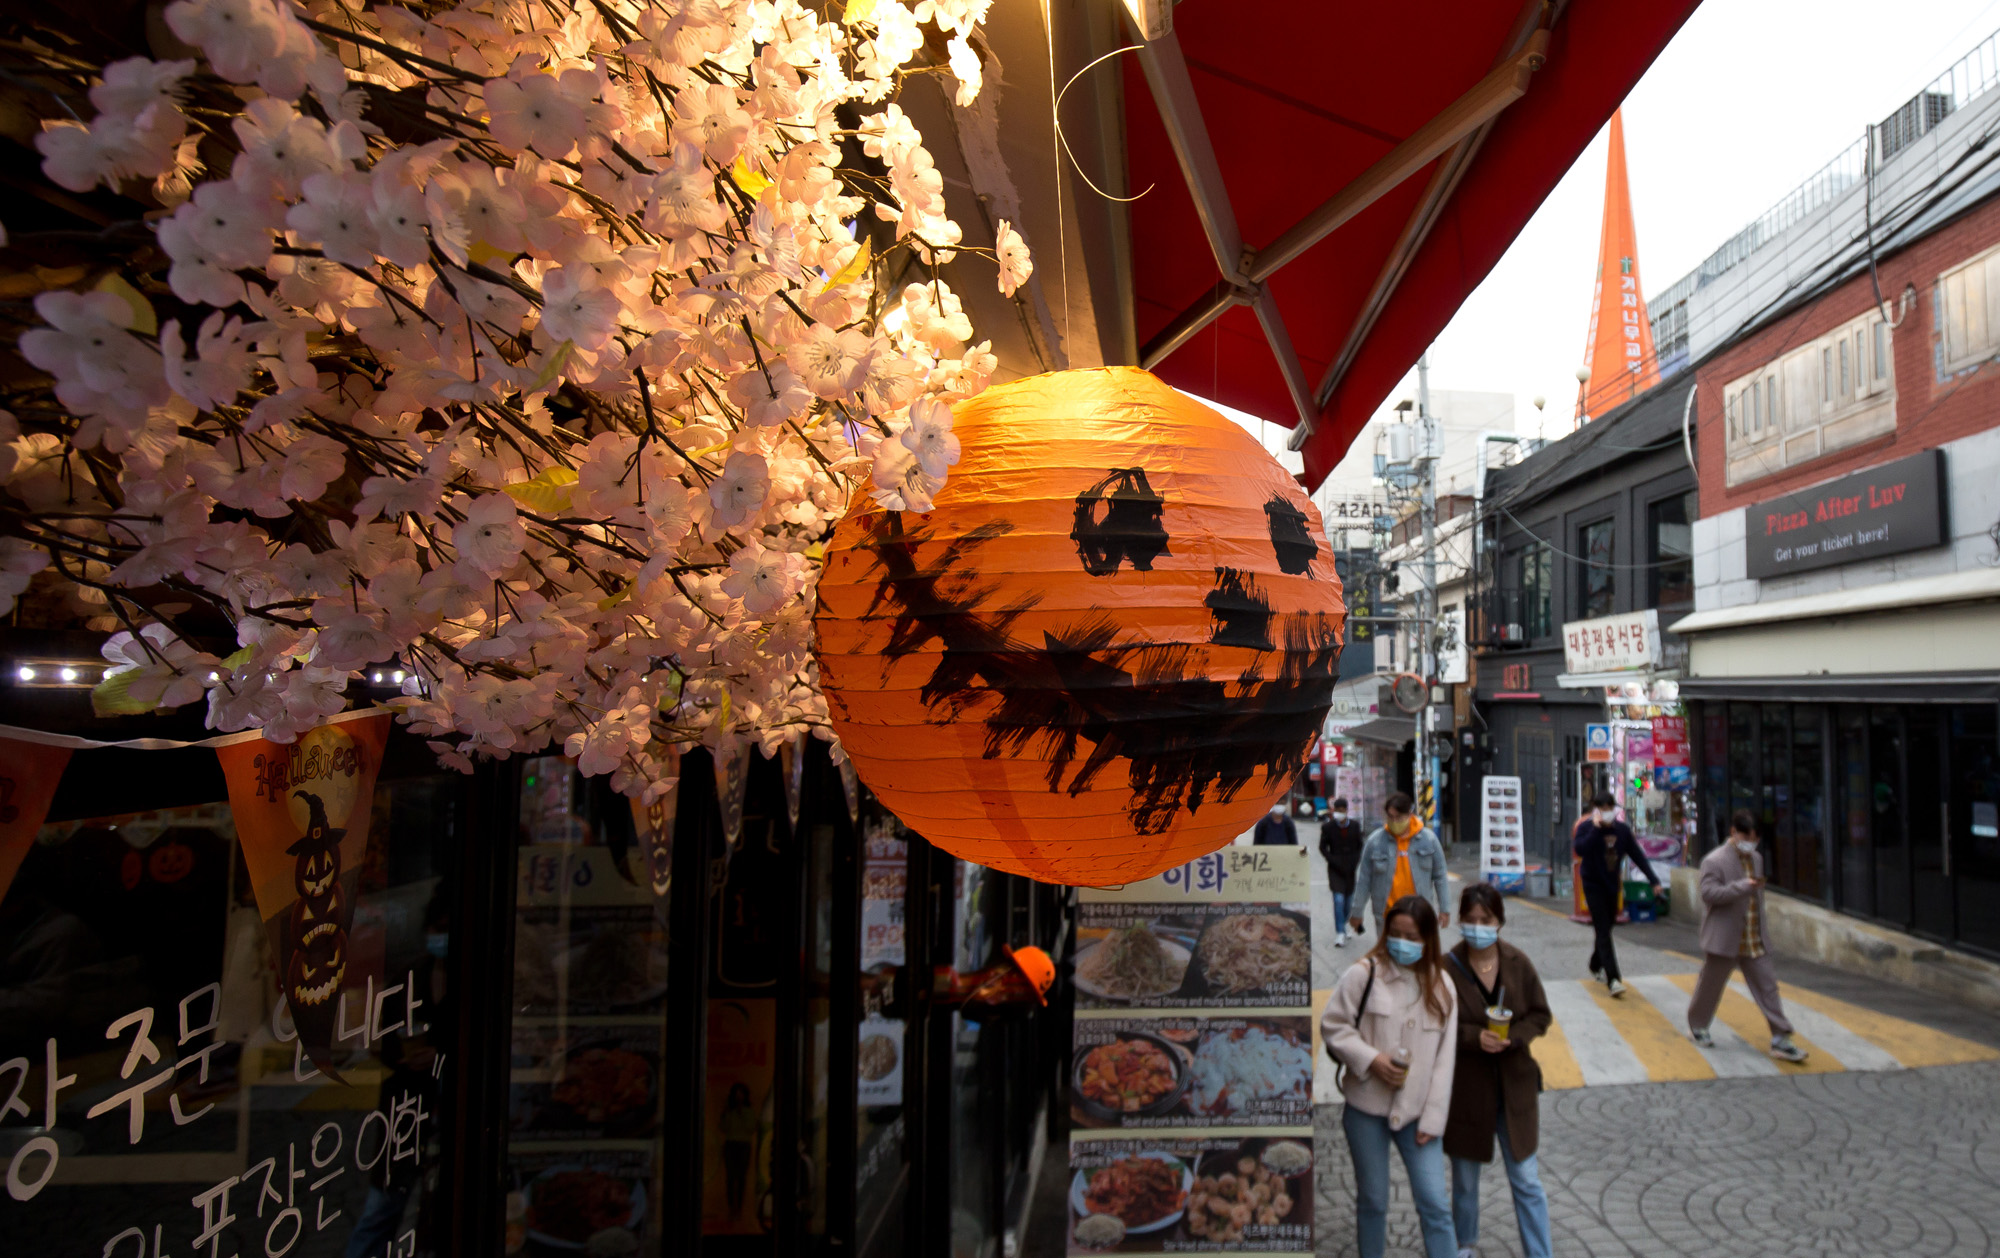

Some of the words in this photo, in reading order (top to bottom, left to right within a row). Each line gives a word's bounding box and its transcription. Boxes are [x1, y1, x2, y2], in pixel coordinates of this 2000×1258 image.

[1765, 510, 1808, 536] Pizza
[1815, 495, 1862, 523] After
[1868, 483, 1907, 510] Luv
[1775, 547, 1792, 562] Get
[1796, 543, 1820, 561] your
[1821, 533, 1854, 552] ticket
[1858, 523, 1889, 546] here!
[253, 740, 365, 803] Halloween
[1324, 746, 1338, 762] P
[87, 982, 227, 1145] 주문
[355, 1089, 429, 1188] 이화
